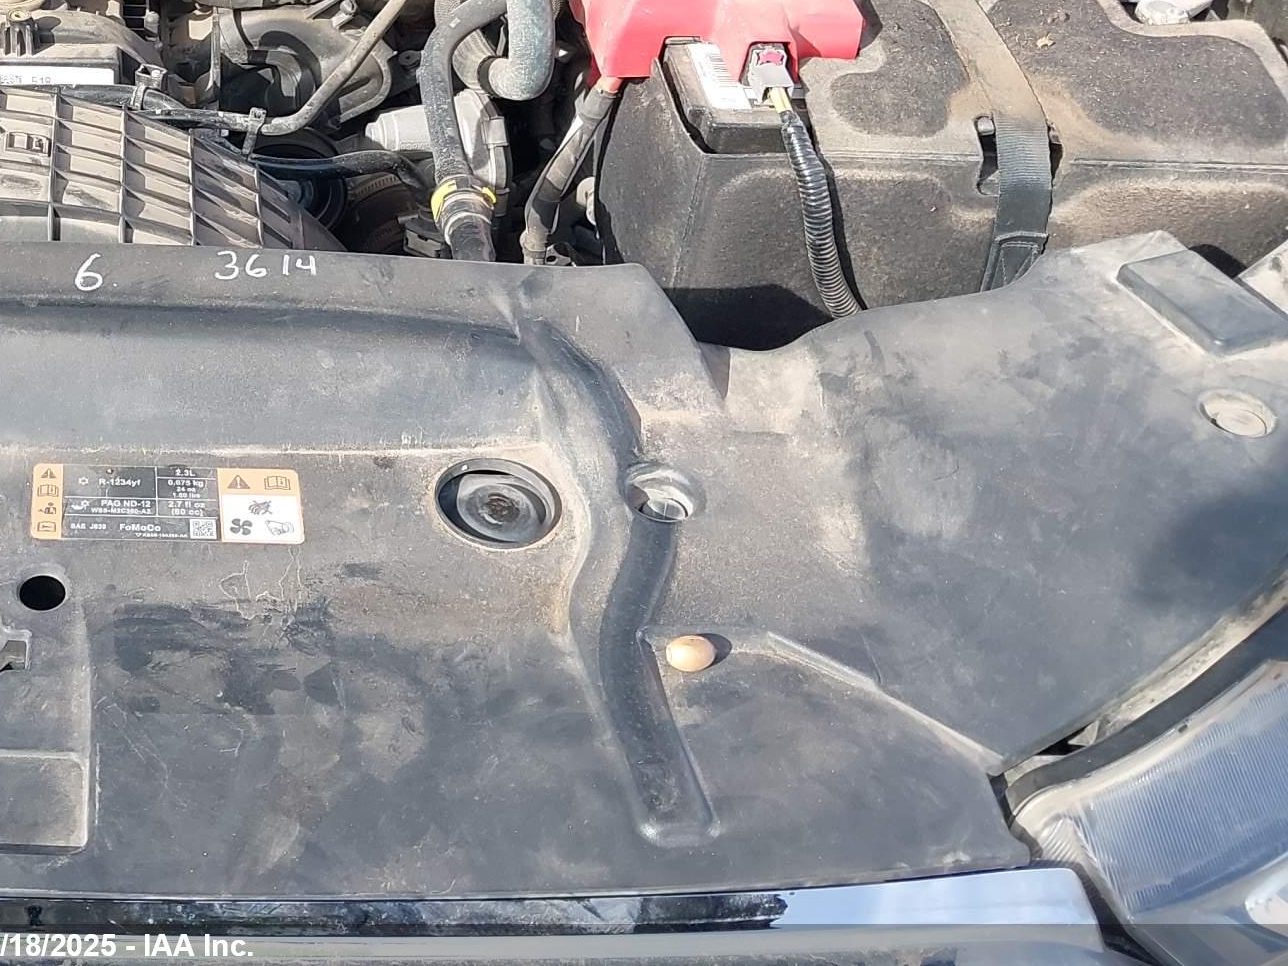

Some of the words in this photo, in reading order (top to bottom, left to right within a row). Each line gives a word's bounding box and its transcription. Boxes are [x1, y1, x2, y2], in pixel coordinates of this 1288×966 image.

[214, 250, 317, 281] 3614
[175, 469, 196, 477] 2.3L
[98, 478, 142, 488] R-1234yf
[192, 480, 204, 488] kg
[123, 500, 152, 508] ND-12
[119, 523, 162, 532] FoMoCo
